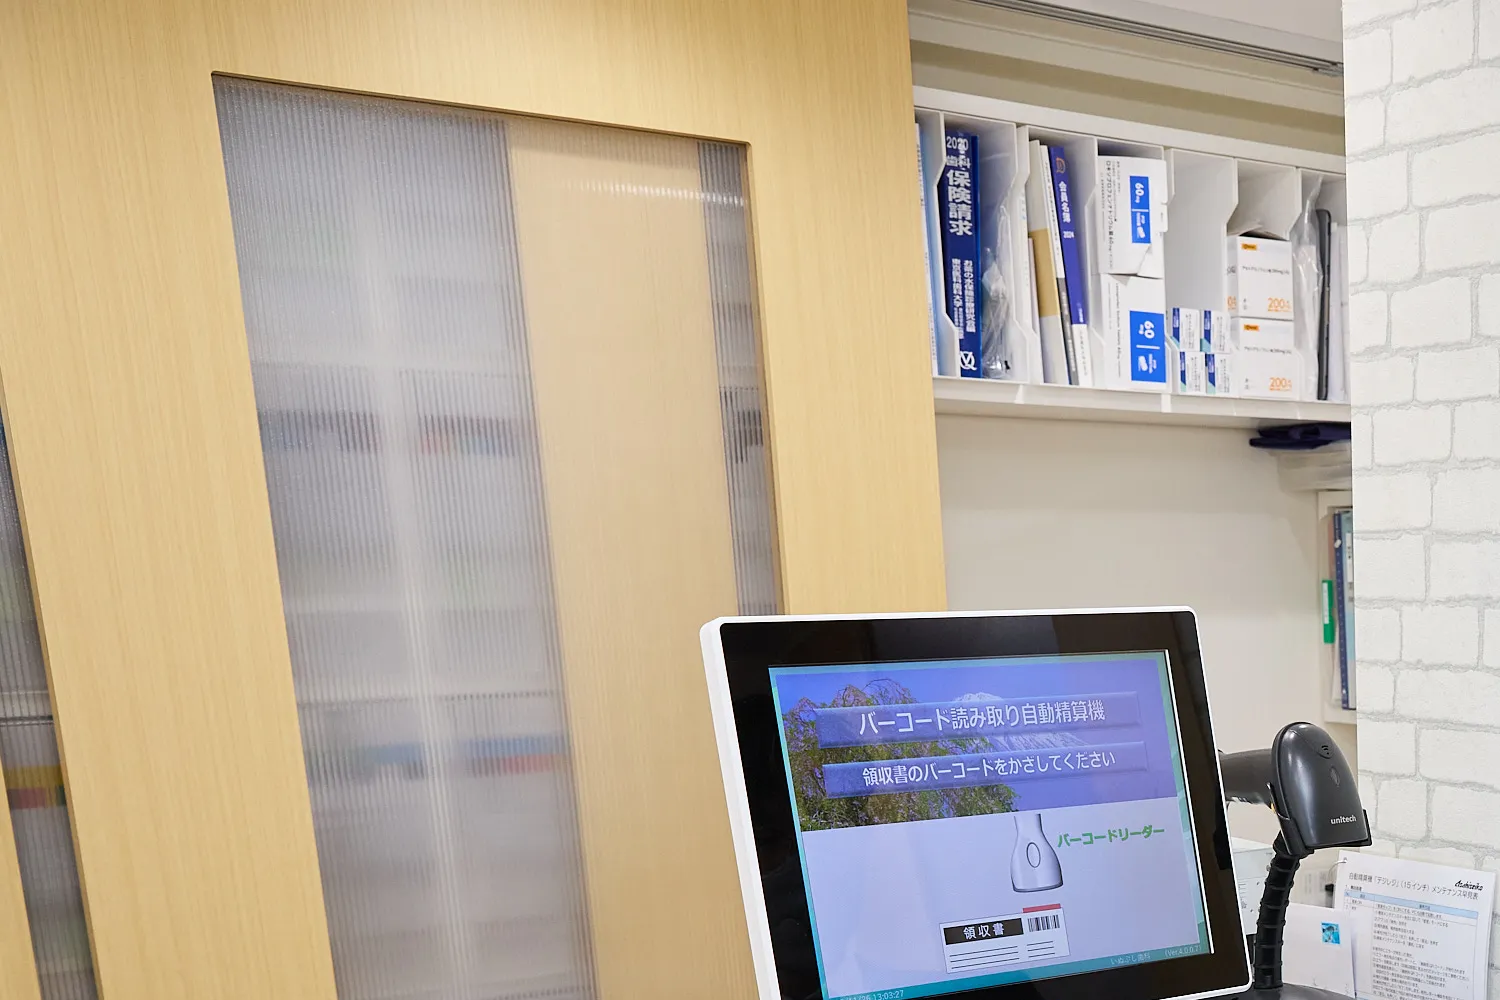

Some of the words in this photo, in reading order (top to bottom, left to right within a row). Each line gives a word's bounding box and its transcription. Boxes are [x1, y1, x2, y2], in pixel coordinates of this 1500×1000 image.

[1144, 320, 1155, 339] 60
[859, 699, 1106, 736] バーコード読み取り自動精算機
[862, 751, 1116, 787] 領収書のバーコードをかざしてください
[1330, 814, 1357, 825] unitech
[1057, 824, 1165, 848] バーコードリーダー
[963, 922, 1005, 940] 領収書
